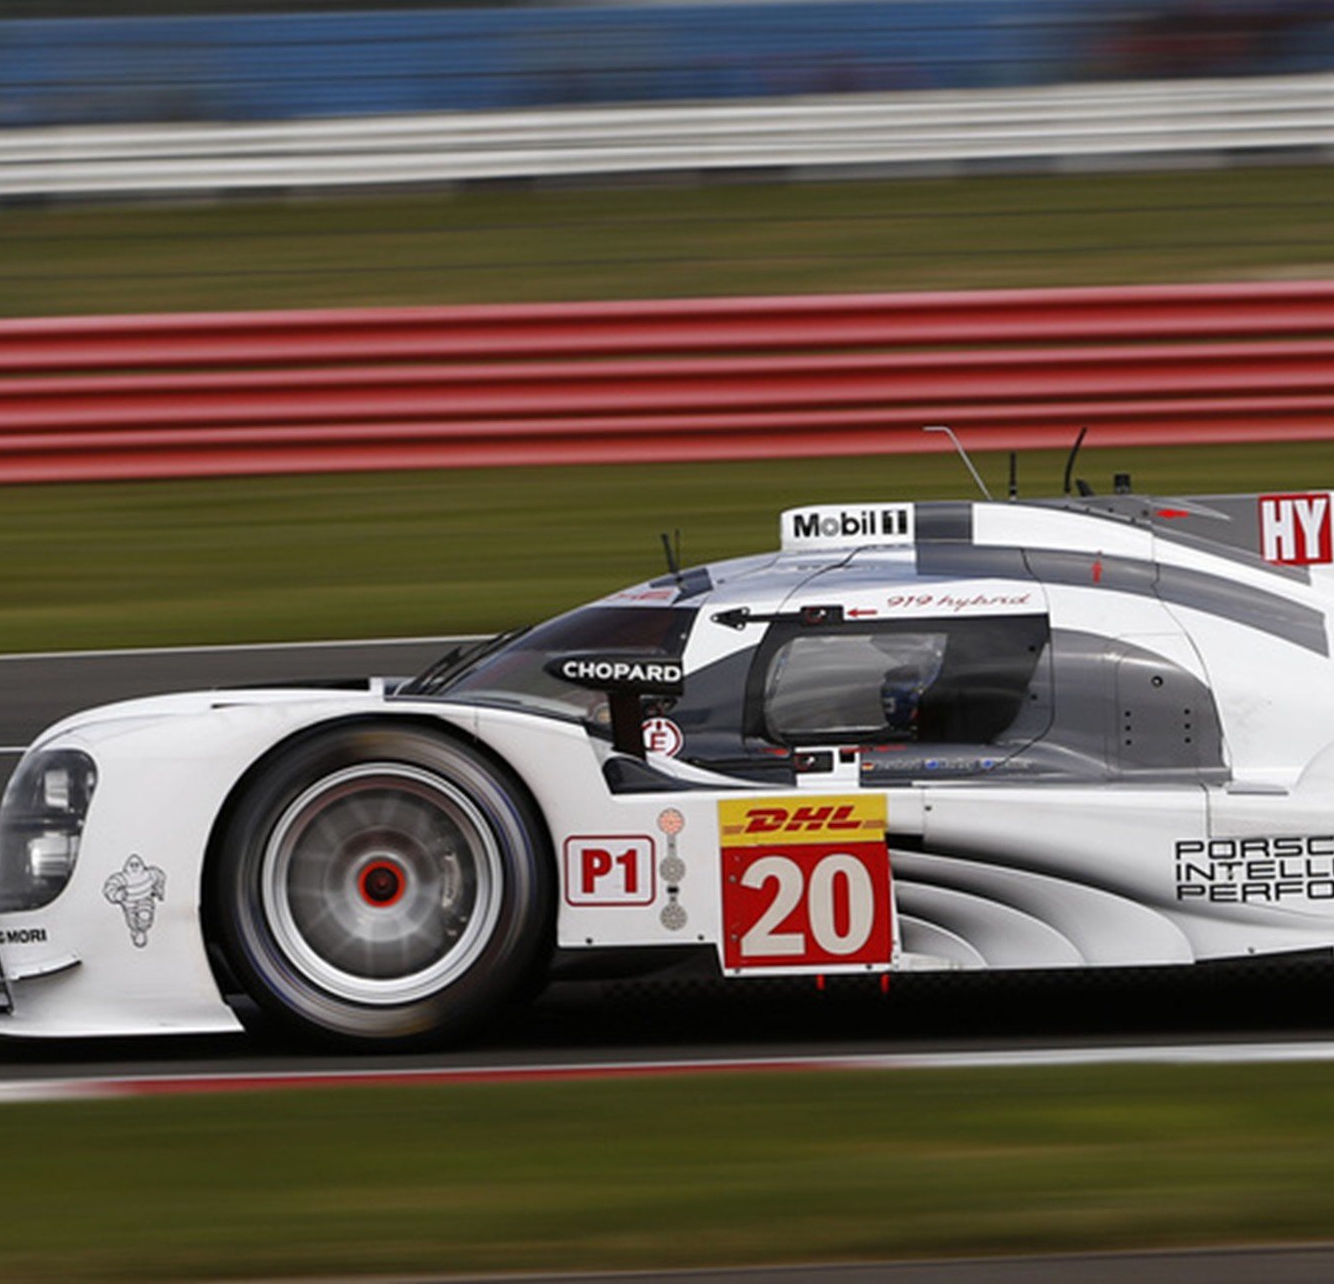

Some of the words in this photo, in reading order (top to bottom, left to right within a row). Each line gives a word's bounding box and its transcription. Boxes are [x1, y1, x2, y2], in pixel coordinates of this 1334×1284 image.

[793, 510, 875, 537] Mobil
[1260, 498, 1327, 562] HY
[886, 595, 934, 608] 919
[936, 592, 1033, 612] hybrid
[563, 661, 683, 682] CHOPARD
[742, 805, 863, 834] DHL
[581, 848, 638, 894] P1
[740, 852, 876, 957] 20
